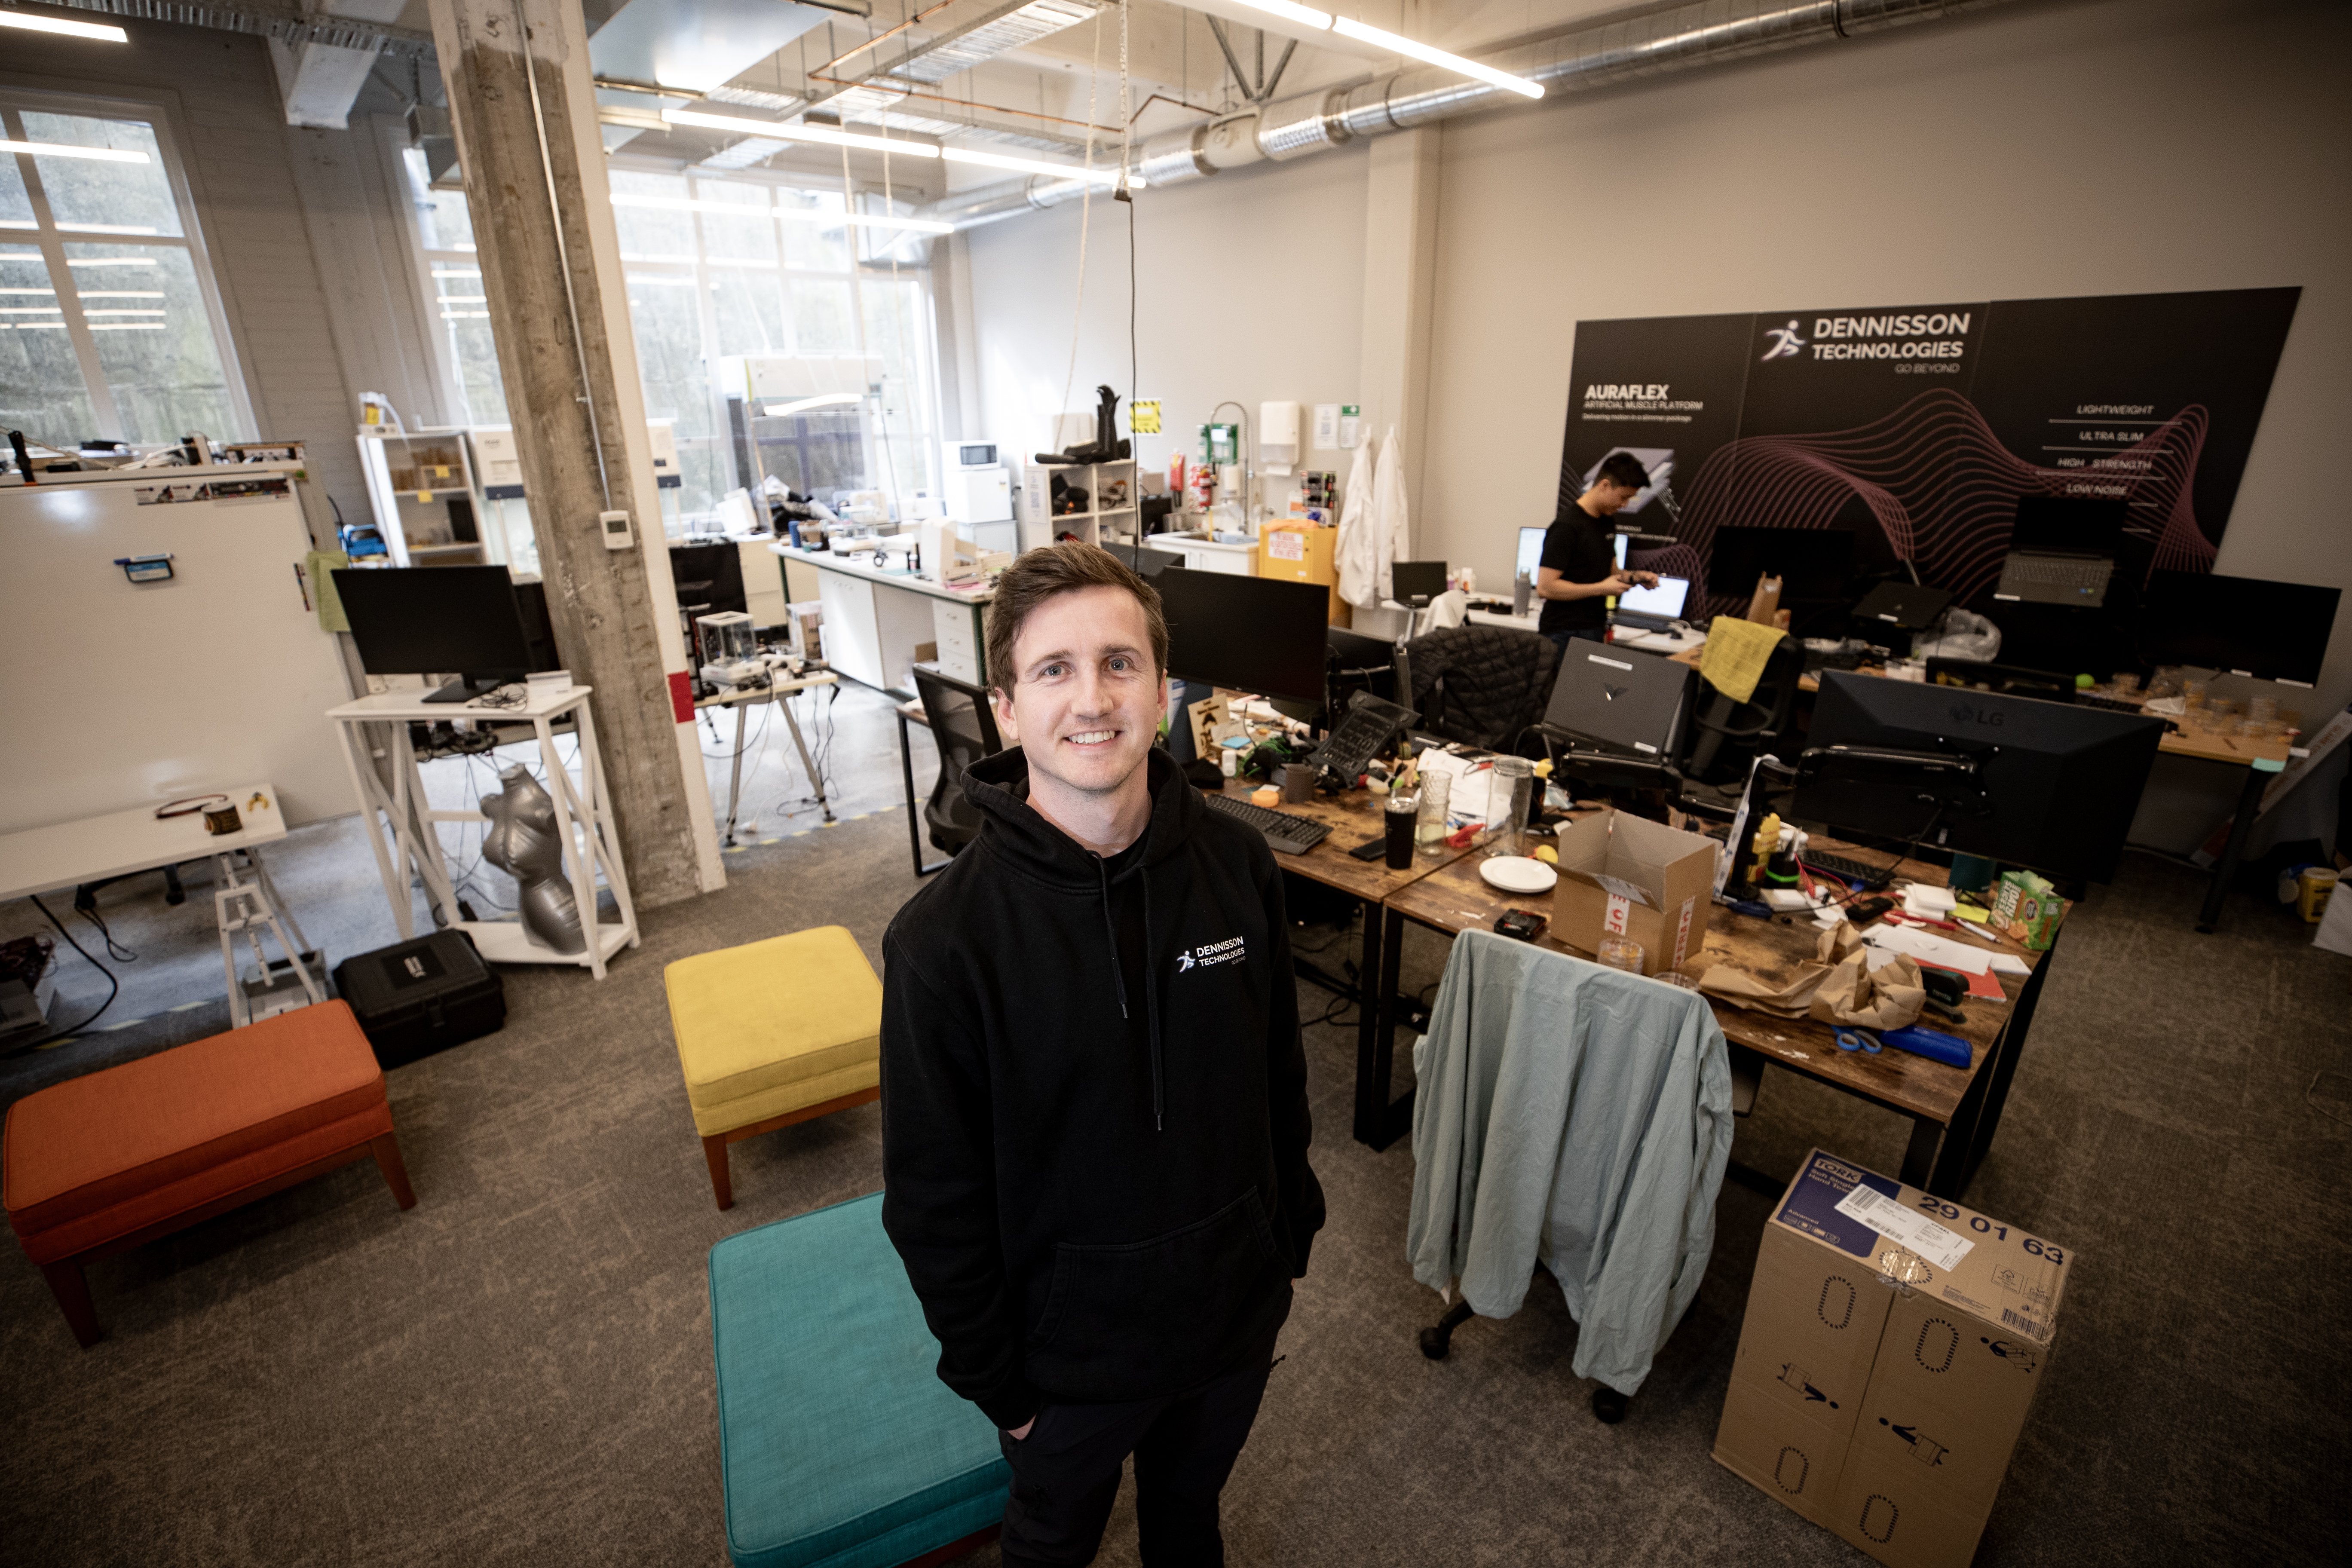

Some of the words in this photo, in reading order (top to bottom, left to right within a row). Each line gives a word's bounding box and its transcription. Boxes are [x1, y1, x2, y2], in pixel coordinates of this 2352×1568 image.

[1813, 313, 1971, 339] DENNISSON
[1812, 341, 1964, 360] TECHNOLOGIES
[1894, 363, 1913, 374] GO
[1913, 363, 1960, 374] BEYOND
[1584, 384, 1669, 400] AURAFLEX
[1583, 401, 1623, 410] ARTIFICIAL
[1625, 401, 1657, 410] MUSCLE
[1659, 401, 1703, 411] PLATFORM
[2076, 404, 2155, 415] LIGHTWEIGHT
[2079, 431, 2115, 441] ULTRA
[2116, 432, 2144, 441] SLIM
[2057, 457, 2086, 468] HIGH
[2091, 459, 2152, 470] STRENGTH
[2065, 484, 2092, 494] LOW
[2093, 484, 2128, 496] NOISE
[1978, 710, 2004, 726] LG
[1196, 936, 1243, 957] DENNISSON
[1199, 947, 1245, 967] TECHNOLOGIES
[1819, 1161, 1858, 1180] TORK
[1919, 1196, 1960, 1220] 29
[1970, 1217, 2008, 1241] 01
[2023, 1238, 2063, 1265] 63
